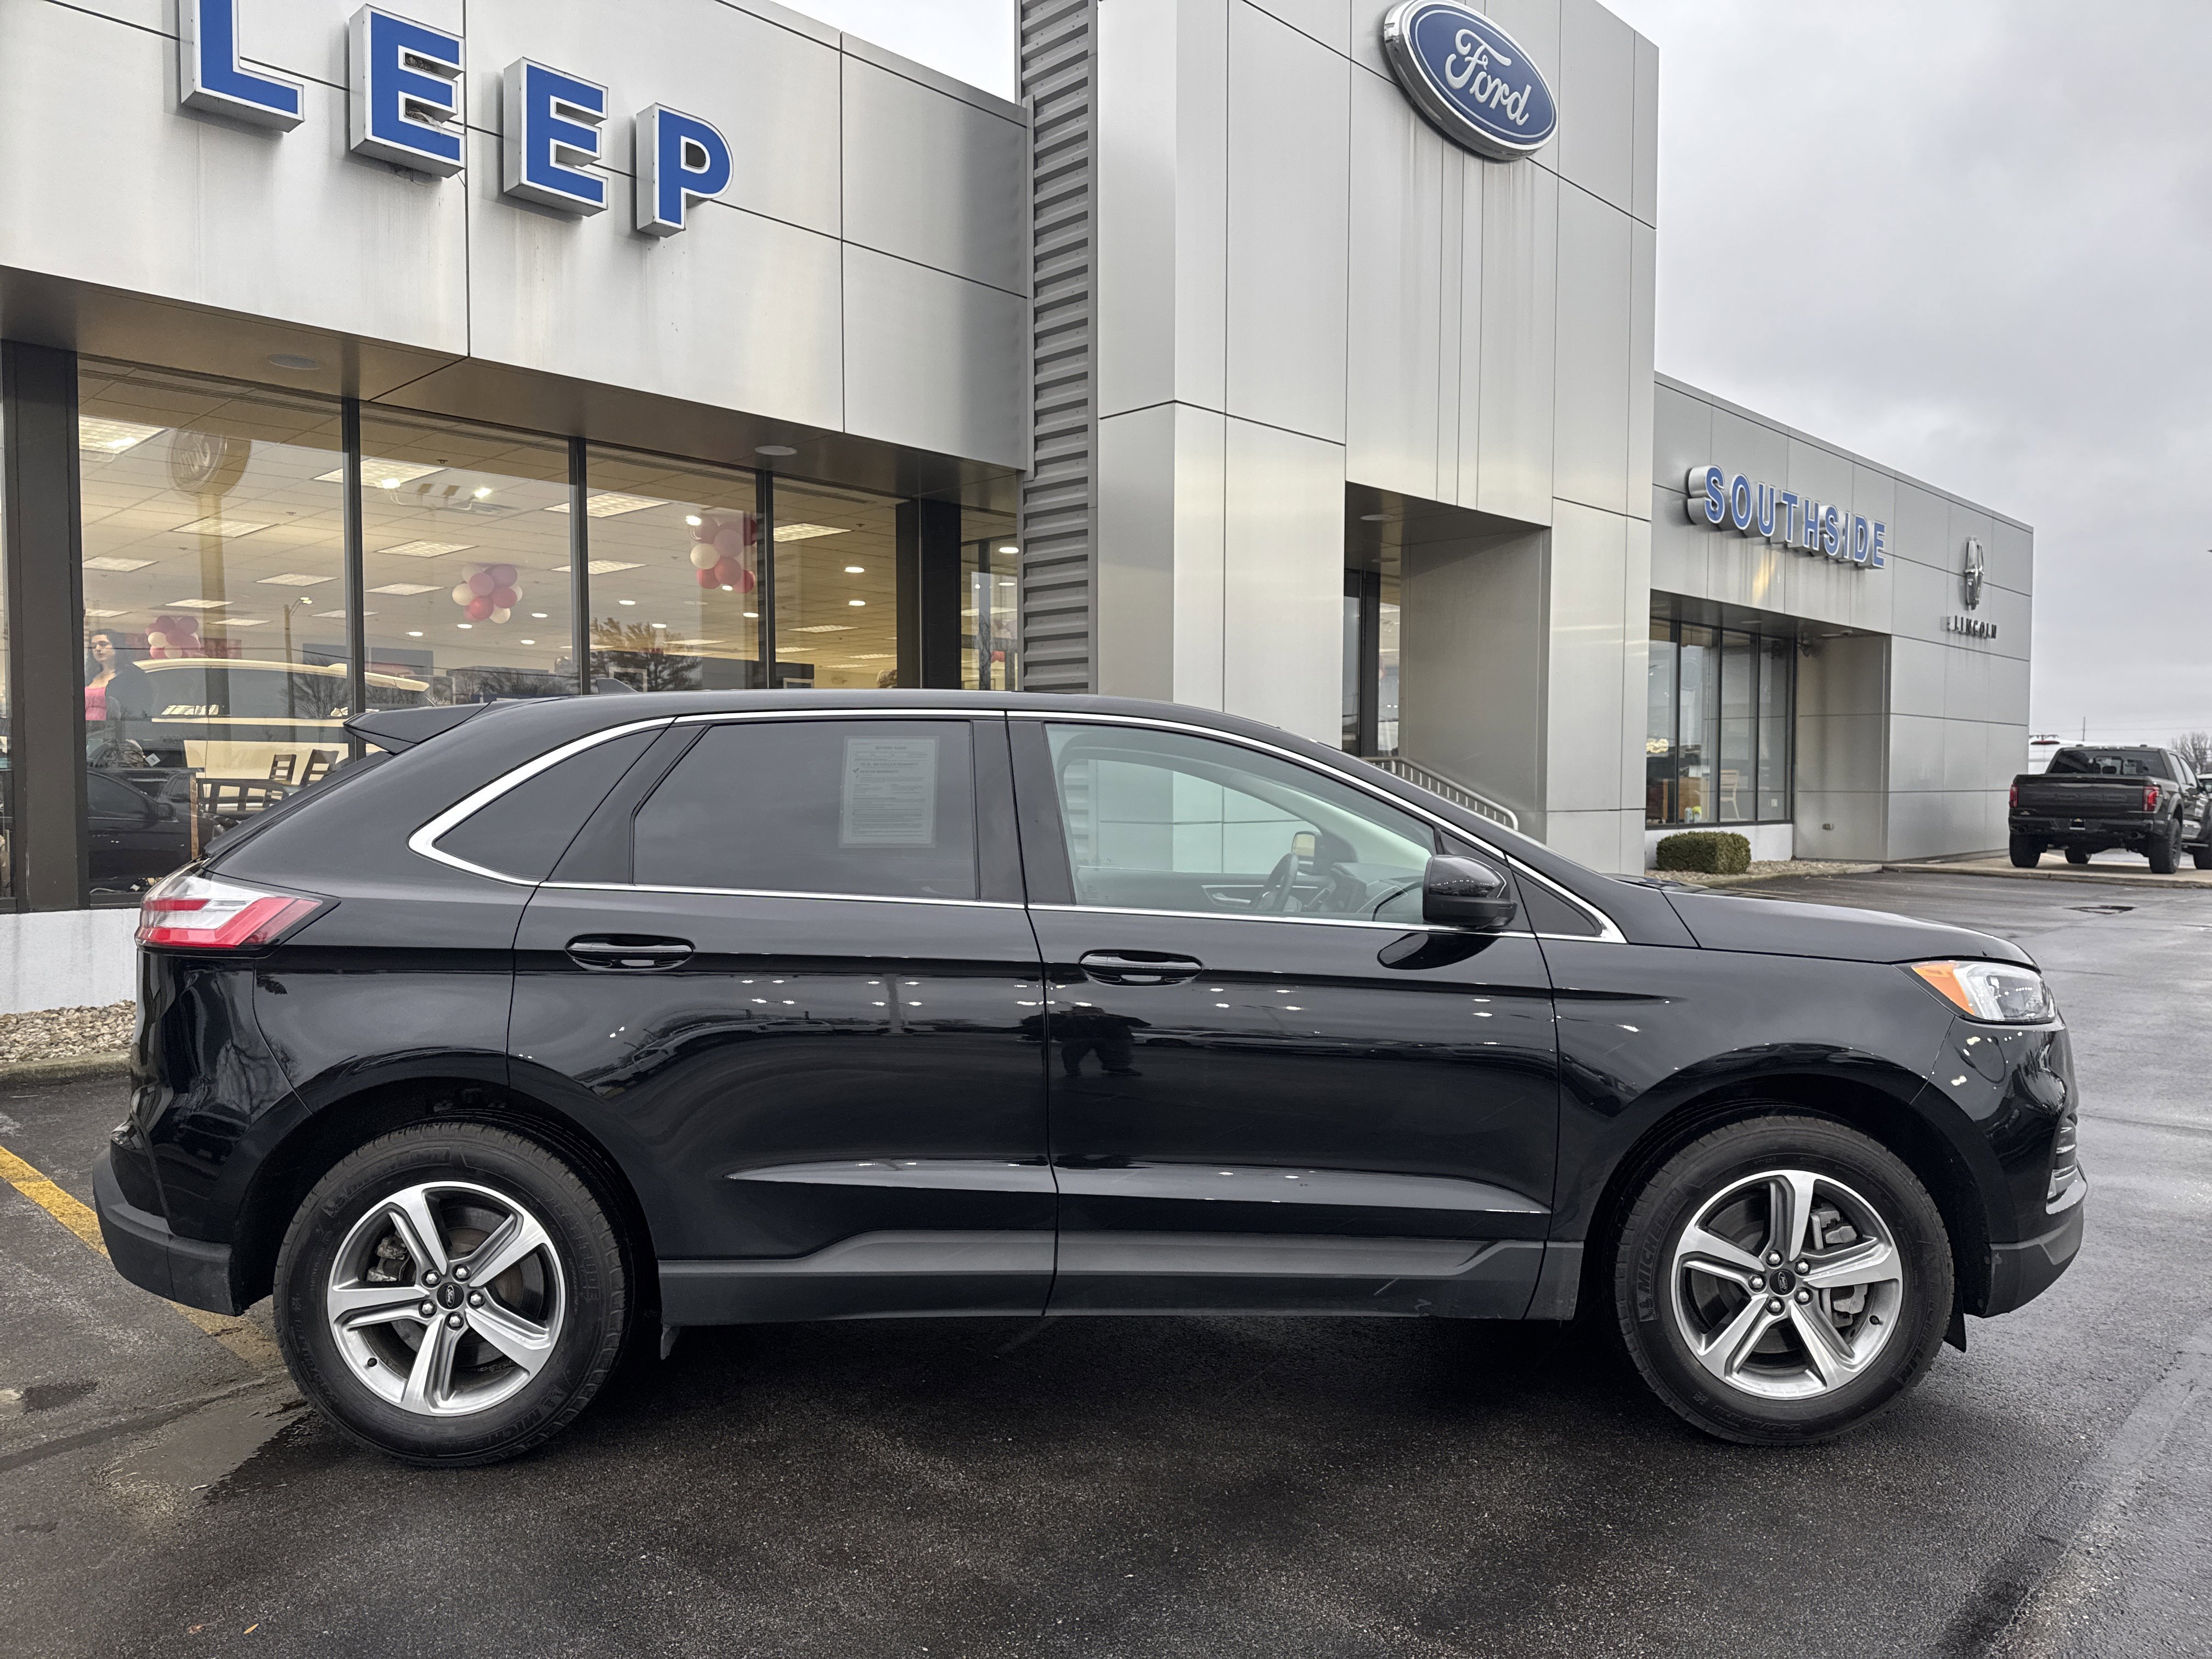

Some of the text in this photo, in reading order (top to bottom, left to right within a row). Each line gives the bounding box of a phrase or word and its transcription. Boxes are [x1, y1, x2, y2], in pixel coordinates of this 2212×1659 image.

[181, 0, 733, 236] LEEP
[1445, 29, 1531, 126] Ford
[1702, 465, 1886, 569] SOUTHSIDE
[1953, 614, 1997, 639] LINCOLN
